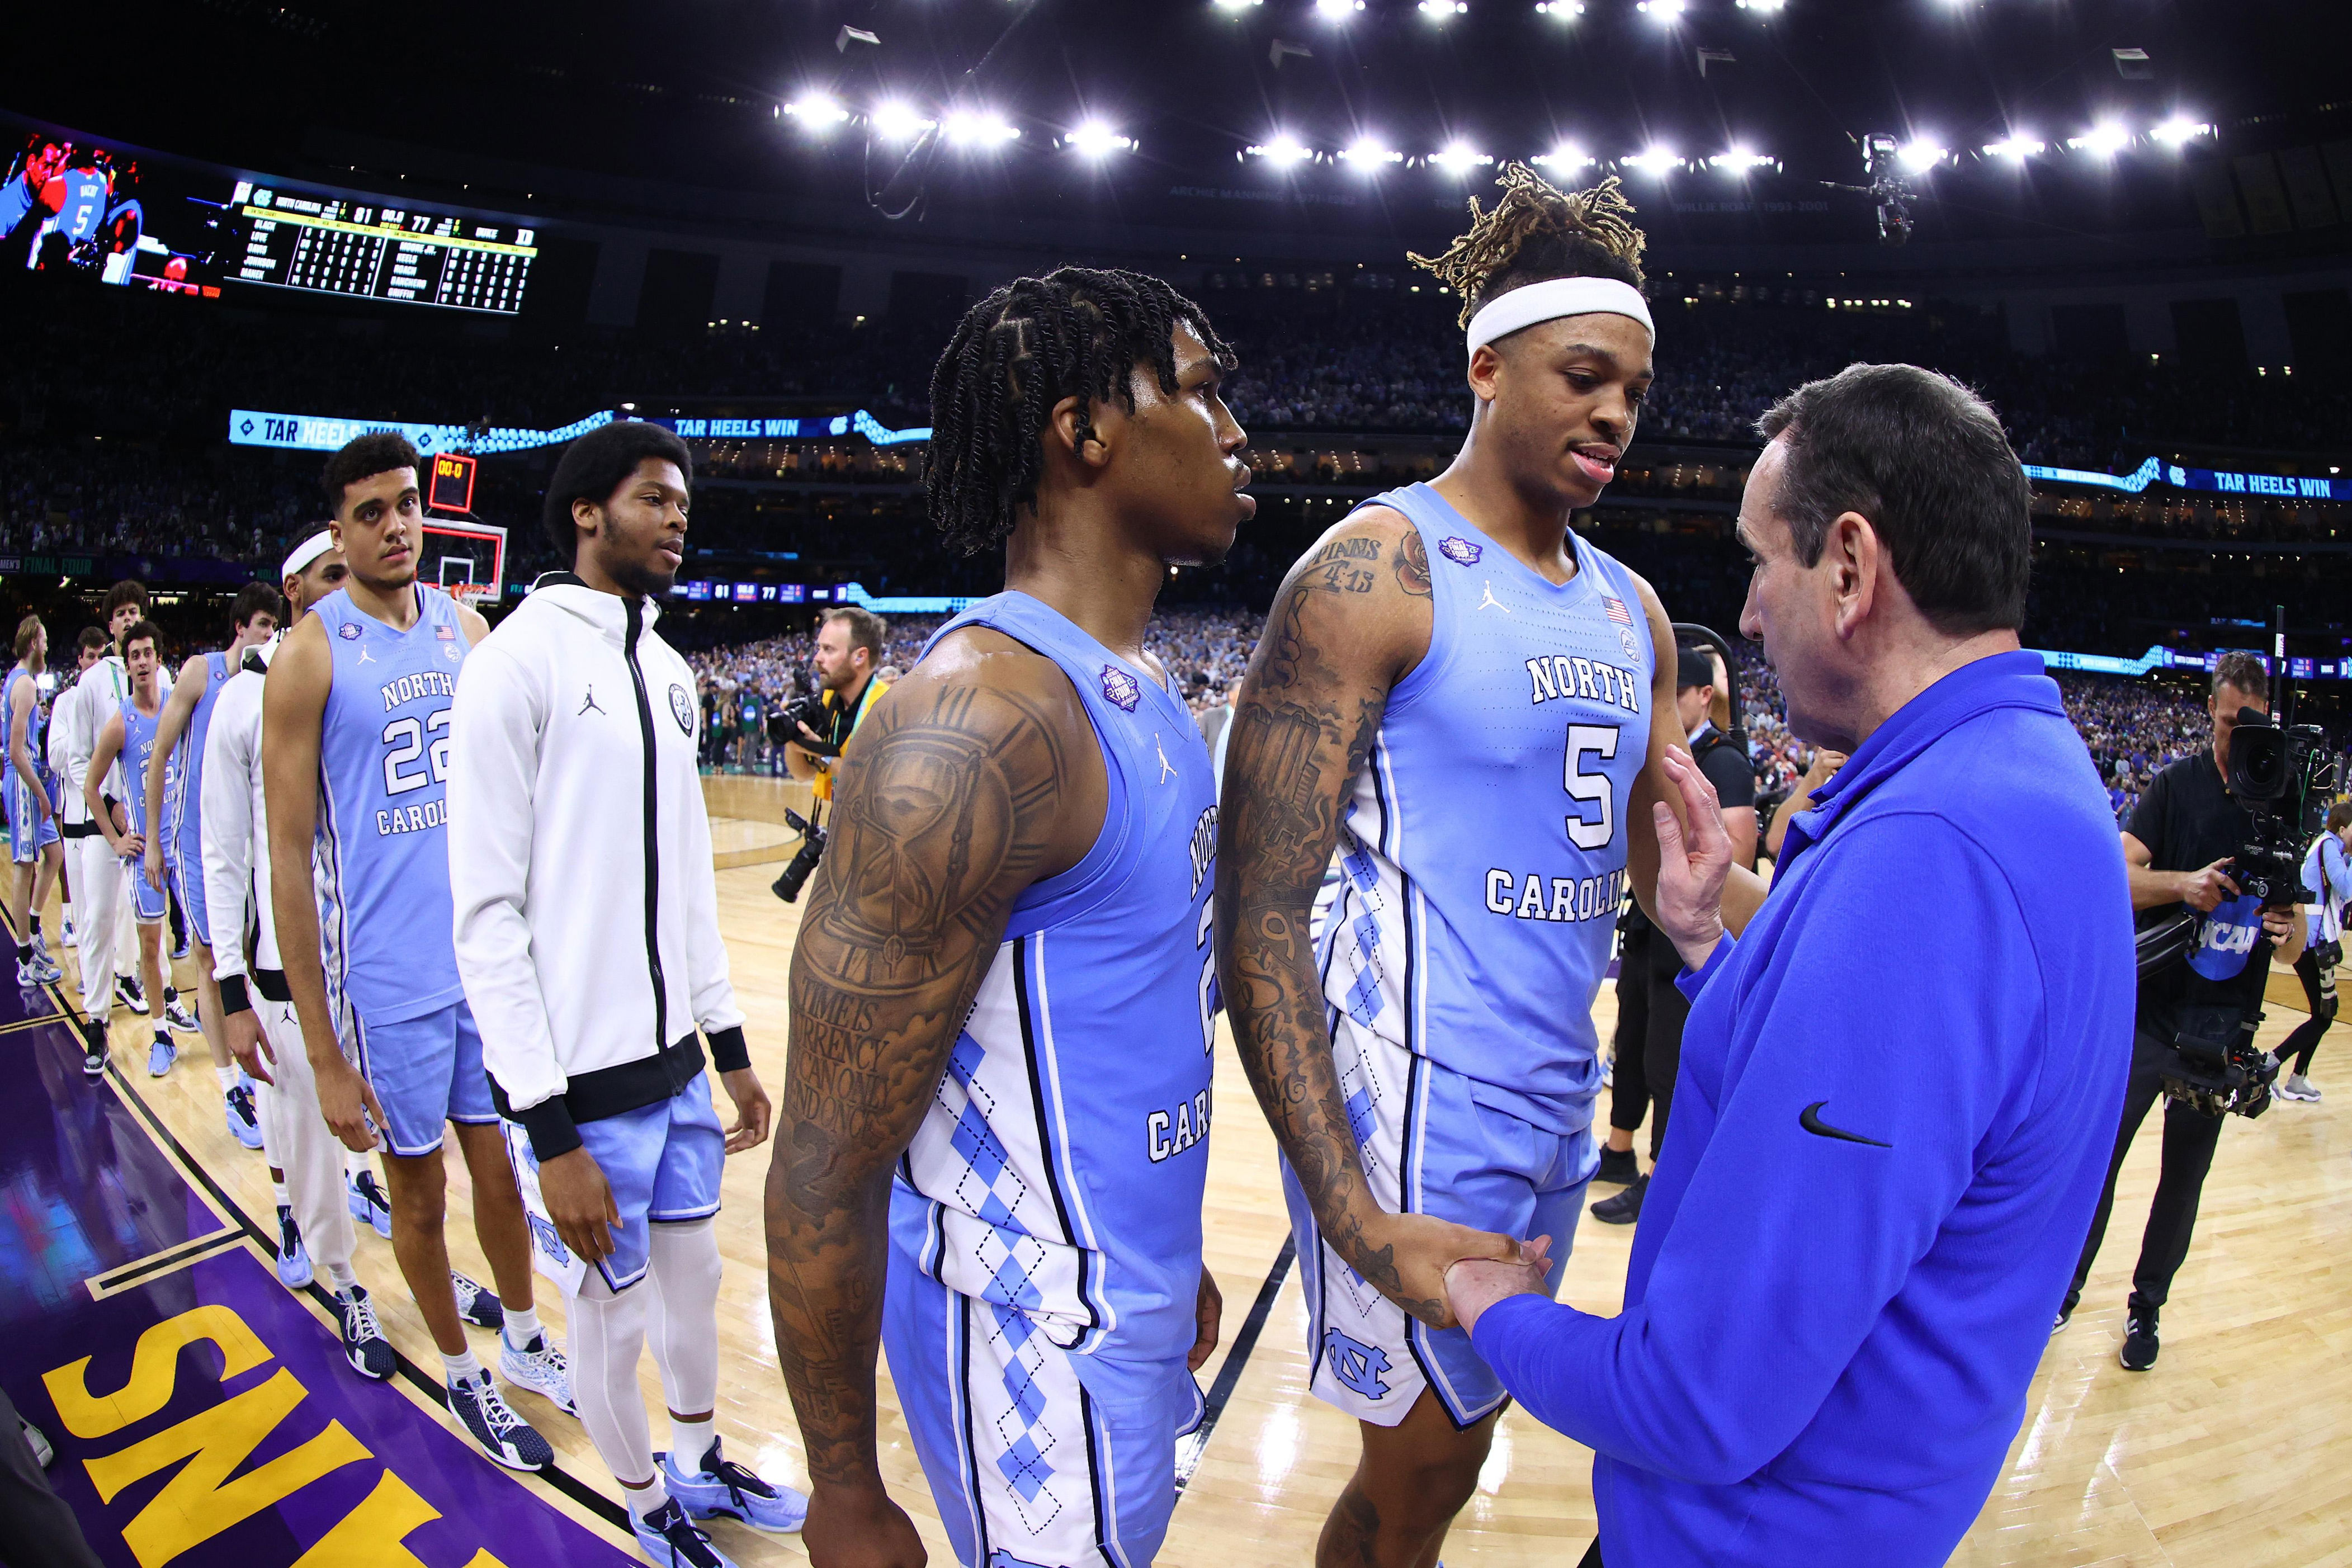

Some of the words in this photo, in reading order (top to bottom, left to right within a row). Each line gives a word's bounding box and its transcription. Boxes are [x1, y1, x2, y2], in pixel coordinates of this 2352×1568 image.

[72, 205, 93, 235] 5
[353, 207, 373, 224] 81
[412, 215, 431, 233] 77
[244, 256, 276, 269] JOHNSON
[264, 418, 298, 442] TAR
[303, 421, 361, 446] HEELS
[675, 419, 706, 437] TAR
[709, 419, 761, 437] HEELS
[765, 419, 800, 437] WIN
[438, 460, 462, 479] 00.0
[2214, 471, 2246, 493] TAR
[2249, 474, 2297, 496] HEELS
[2299, 478, 2331, 498] WIN
[24, 558, 57, 574] FINAL
[62, 558, 92, 575] FOUR
[714, 584, 729, 599] 81
[762, 587, 776, 600] 77
[381, 672, 454, 712] NORTH
[1109, 673, 1127, 689] FINAL
[1113, 683, 1132, 700] FOUR
[1526, 655, 1640, 714] NORTH
[382, 709, 450, 796] 22
[1564, 723, 1621, 851] 5
[376, 799, 449, 836] CAROL
[1485, 867, 1627, 922] CAROLIN
[2198, 920, 2259, 955] NCAA
